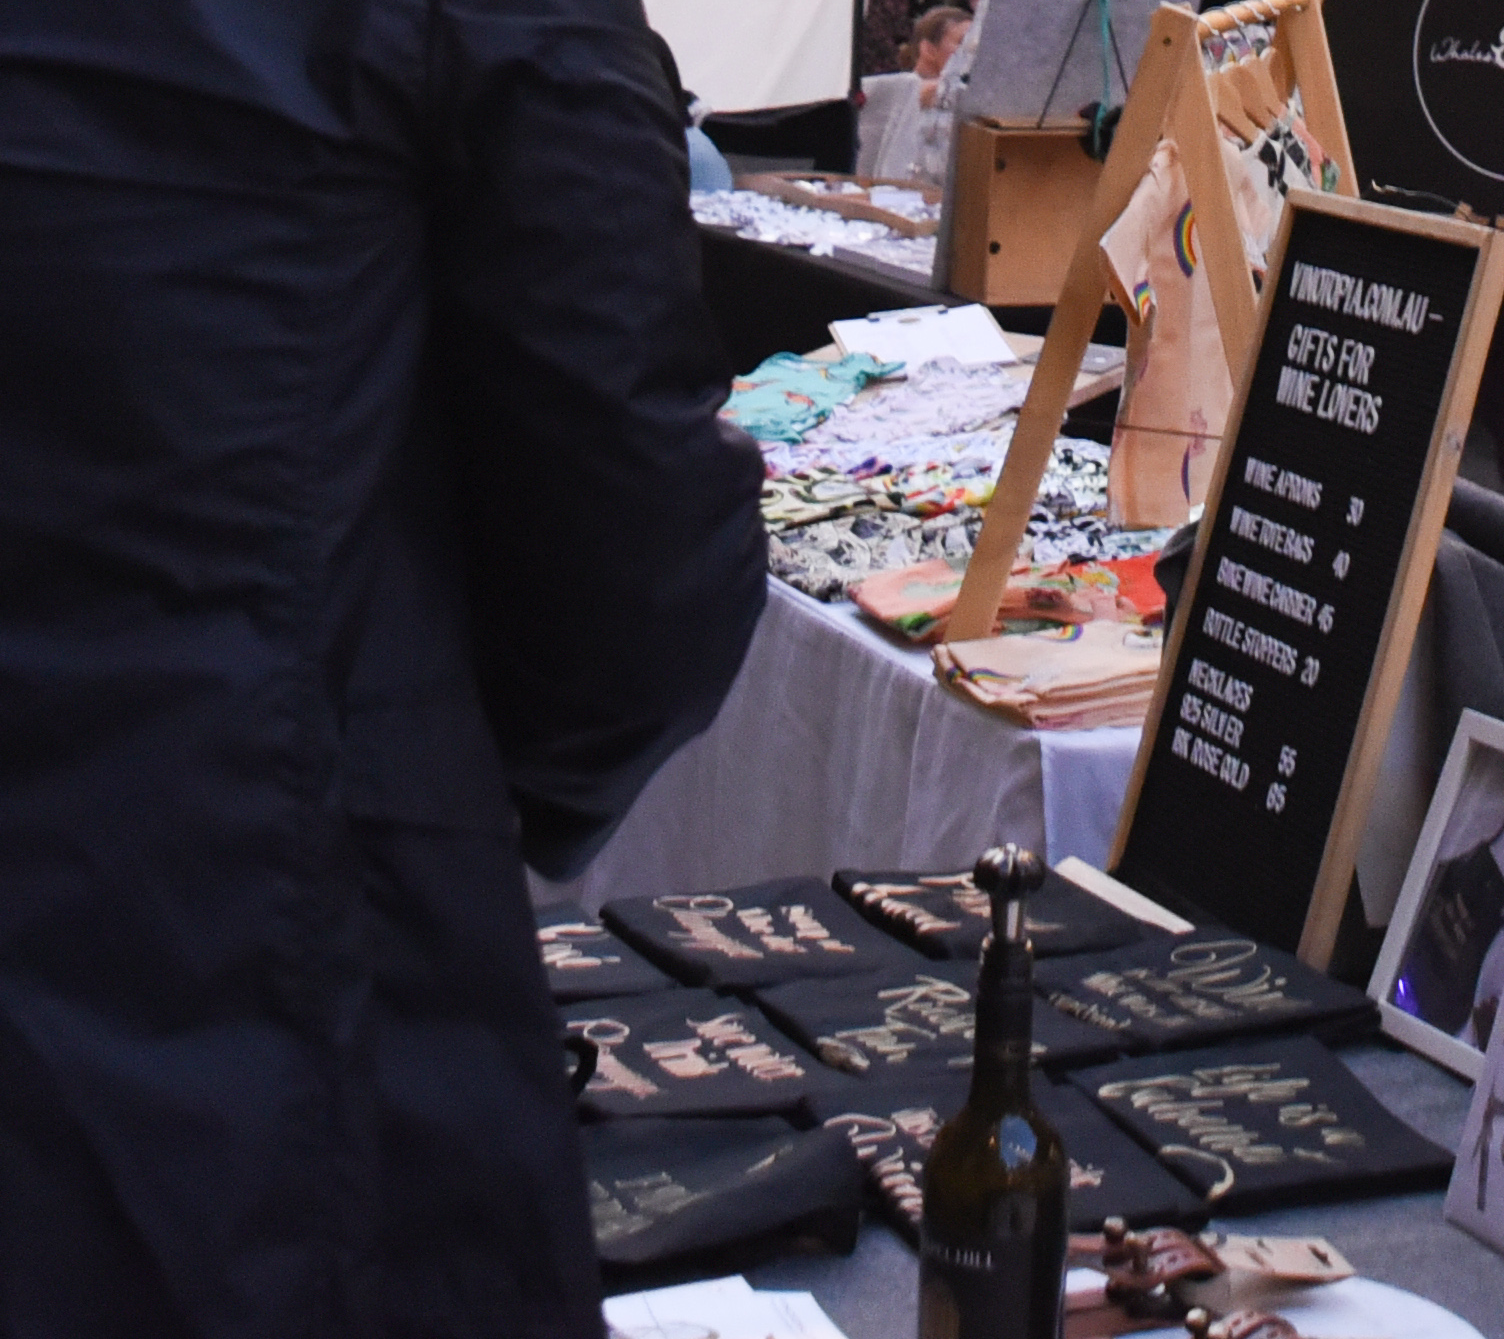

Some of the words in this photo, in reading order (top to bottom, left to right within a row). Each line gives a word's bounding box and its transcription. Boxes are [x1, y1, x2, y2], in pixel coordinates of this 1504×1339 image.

[1289, 260, 1430, 335] VINOTOPIA.COM.AU
[1287, 323, 1339, 374] GIFTS
[1336, 338, 1376, 386] FOR
[1276, 365, 1321, 414] WINE
[1316, 379, 1384, 435] LOVERS
[1244, 456, 1279, 493] WINE
